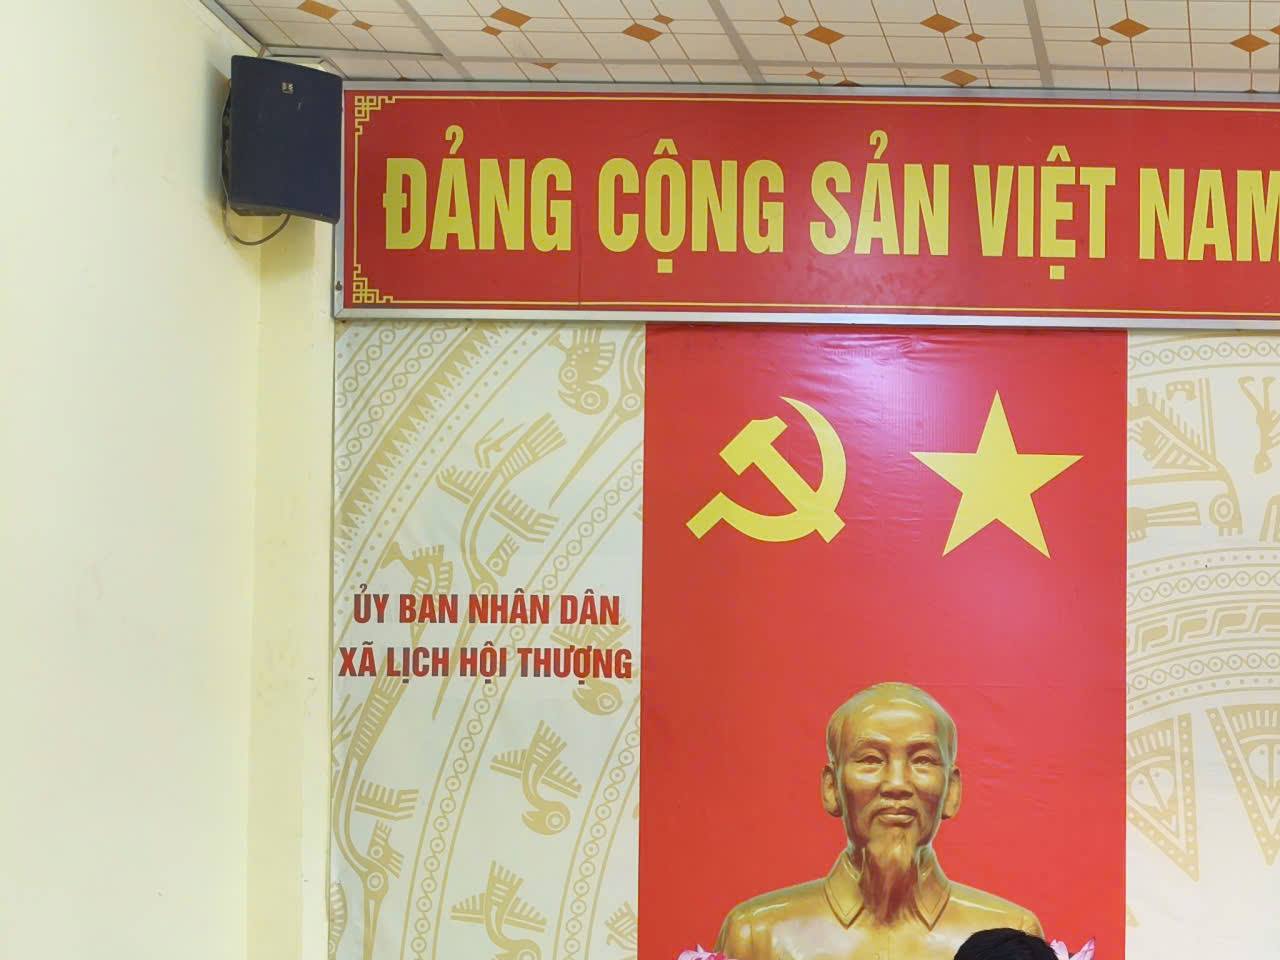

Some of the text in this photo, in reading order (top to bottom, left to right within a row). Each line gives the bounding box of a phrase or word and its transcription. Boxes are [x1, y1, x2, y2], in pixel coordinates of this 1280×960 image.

[382, 124, 572, 253] ĐẢNG
[599, 138, 786, 275] CỘNG
[808, 129, 950, 258] SẢN
[974, 145, 1116, 281] VIỆT
[353, 583, 620, 626] ỦY BAN NHÂN DÂN
[338, 640, 632, 685] XÃ LỊCH HỘI THƯỢNG
